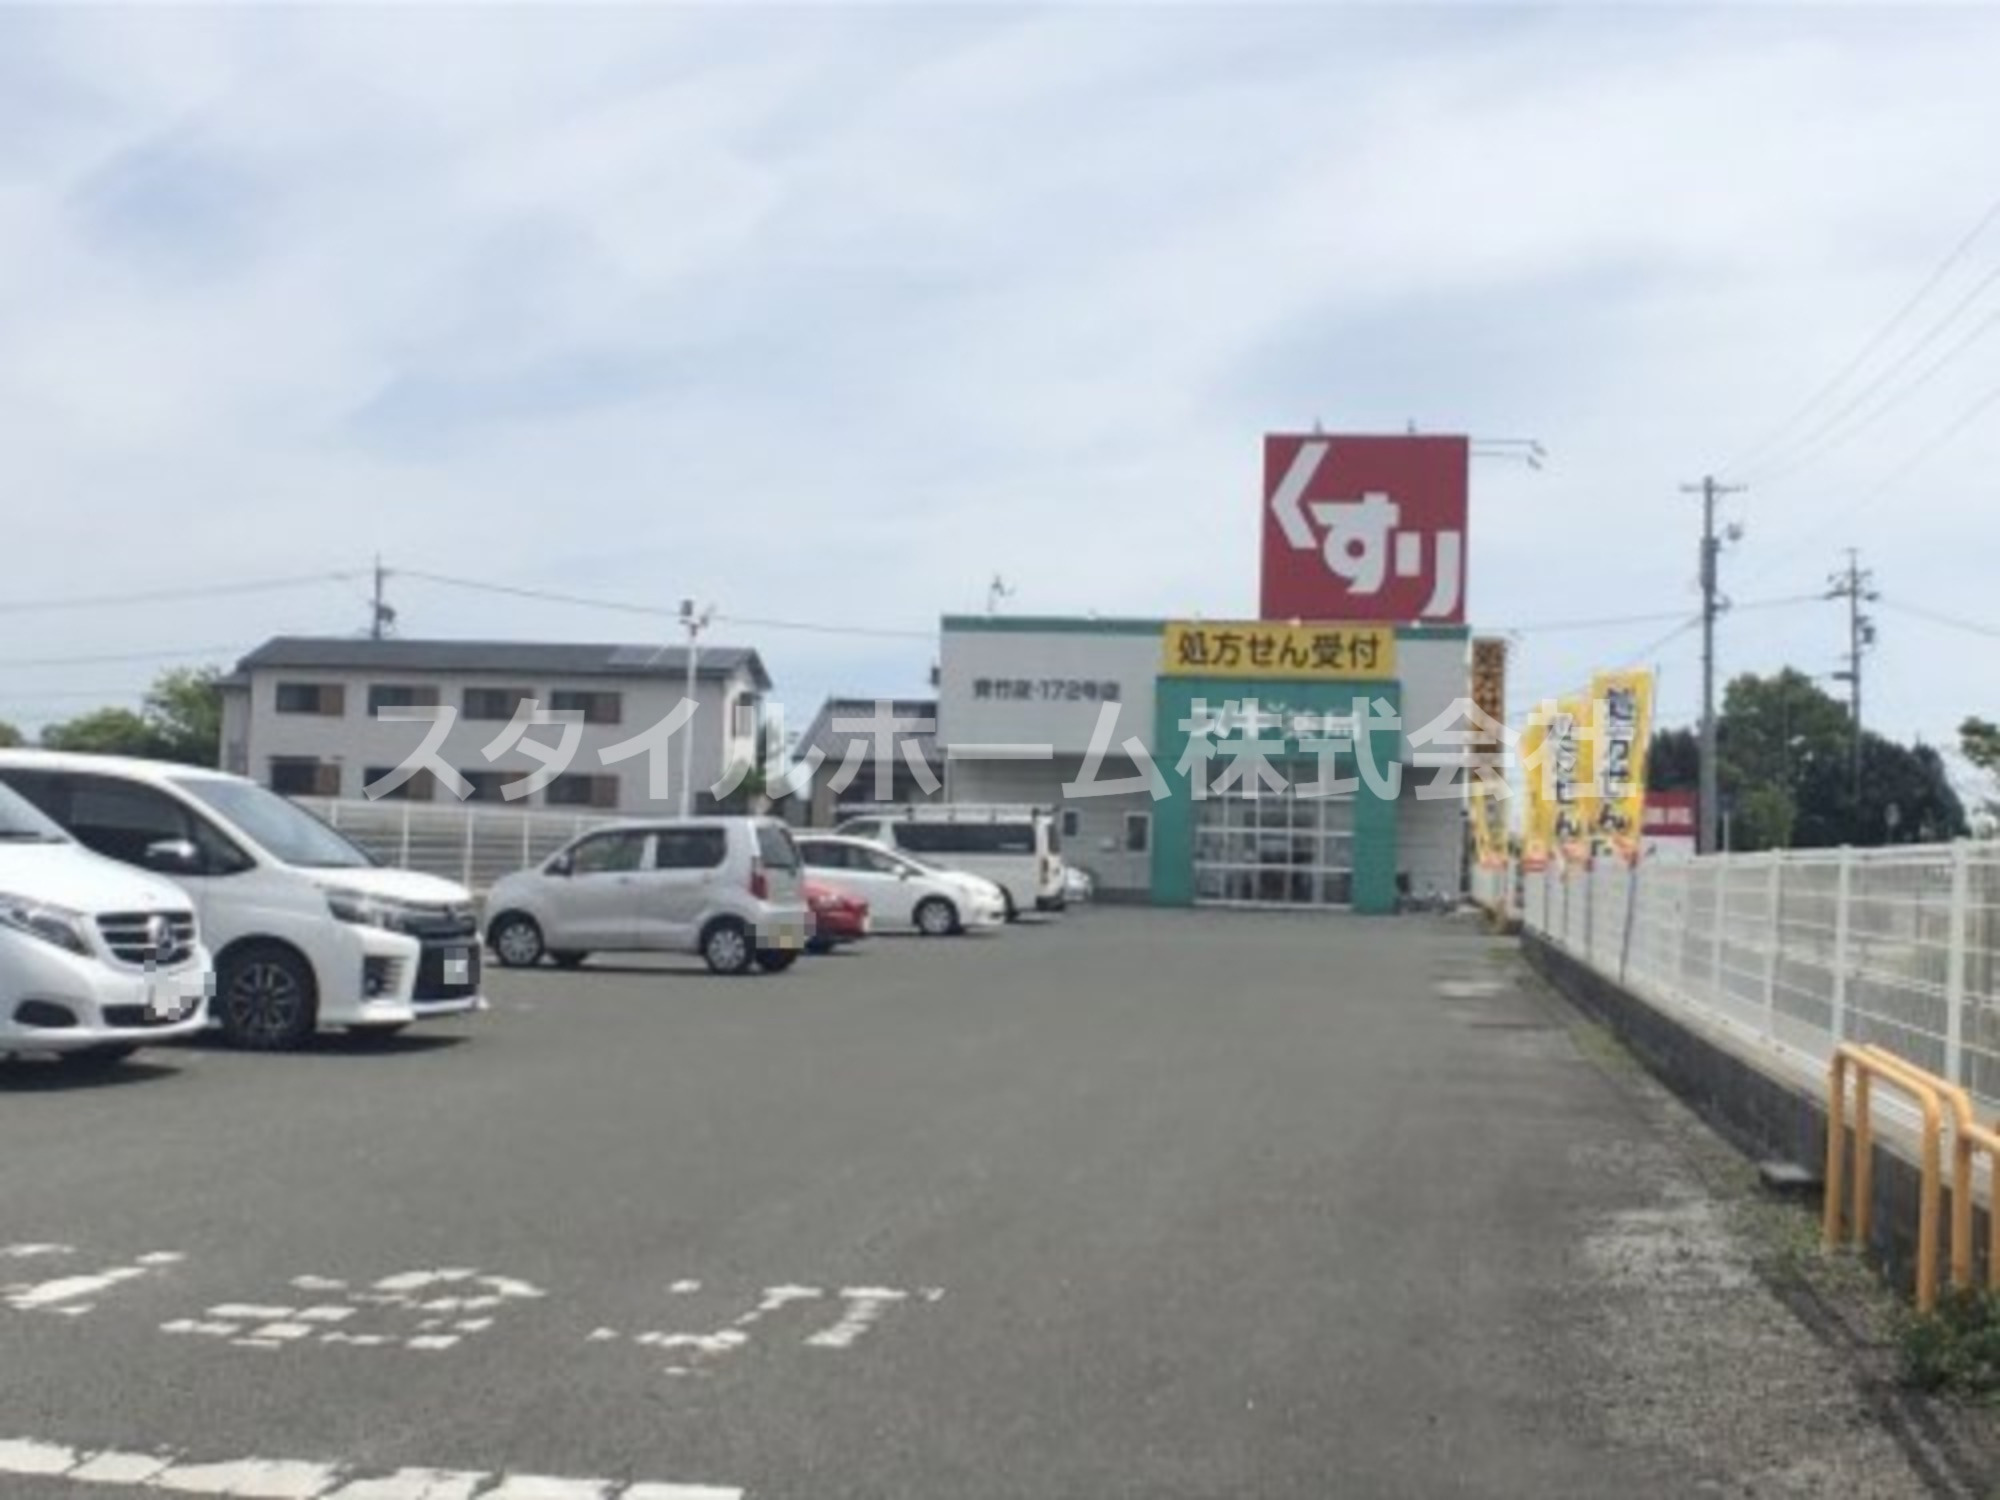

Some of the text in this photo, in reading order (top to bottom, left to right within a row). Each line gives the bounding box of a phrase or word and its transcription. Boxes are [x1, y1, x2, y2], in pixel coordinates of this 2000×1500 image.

[1270, 441, 1460, 617] くすり
[1179, 631, 1380, 669] 処方せん受付
